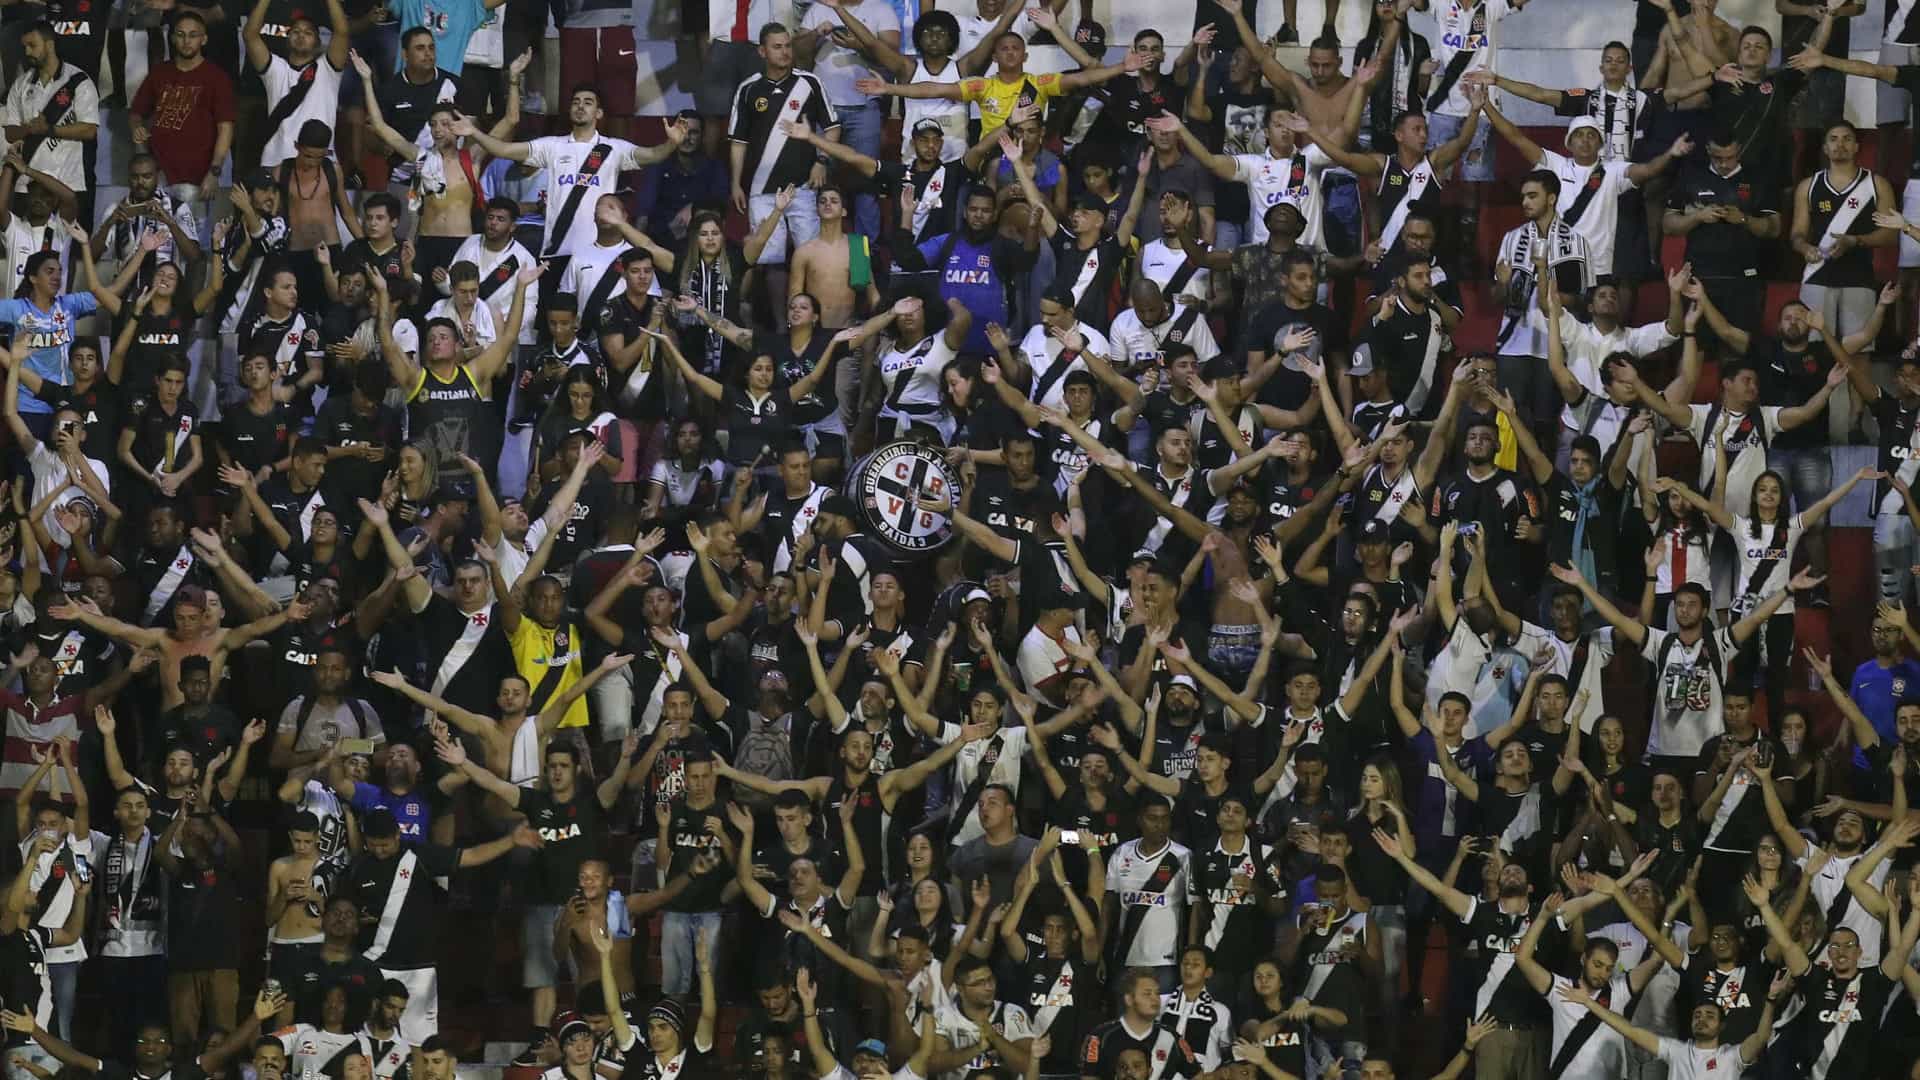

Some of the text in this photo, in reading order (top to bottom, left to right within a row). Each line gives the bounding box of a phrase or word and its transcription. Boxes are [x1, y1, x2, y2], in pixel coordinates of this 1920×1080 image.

[260, 23, 291, 37] AIX
[1443, 33, 1488, 50] CAIXA
[946, 270, 990, 284] CAIXA
[28, 329, 72, 348] AIXA
[883, 357, 923, 373] CAIXA
[865, 445, 915, 493] GUERREIROS
[895, 463, 944, 495] C R
[888, 496, 933, 529] V G
[988, 512, 1034, 533] CAXA
[1122, 891, 1165, 906] CAIXA
